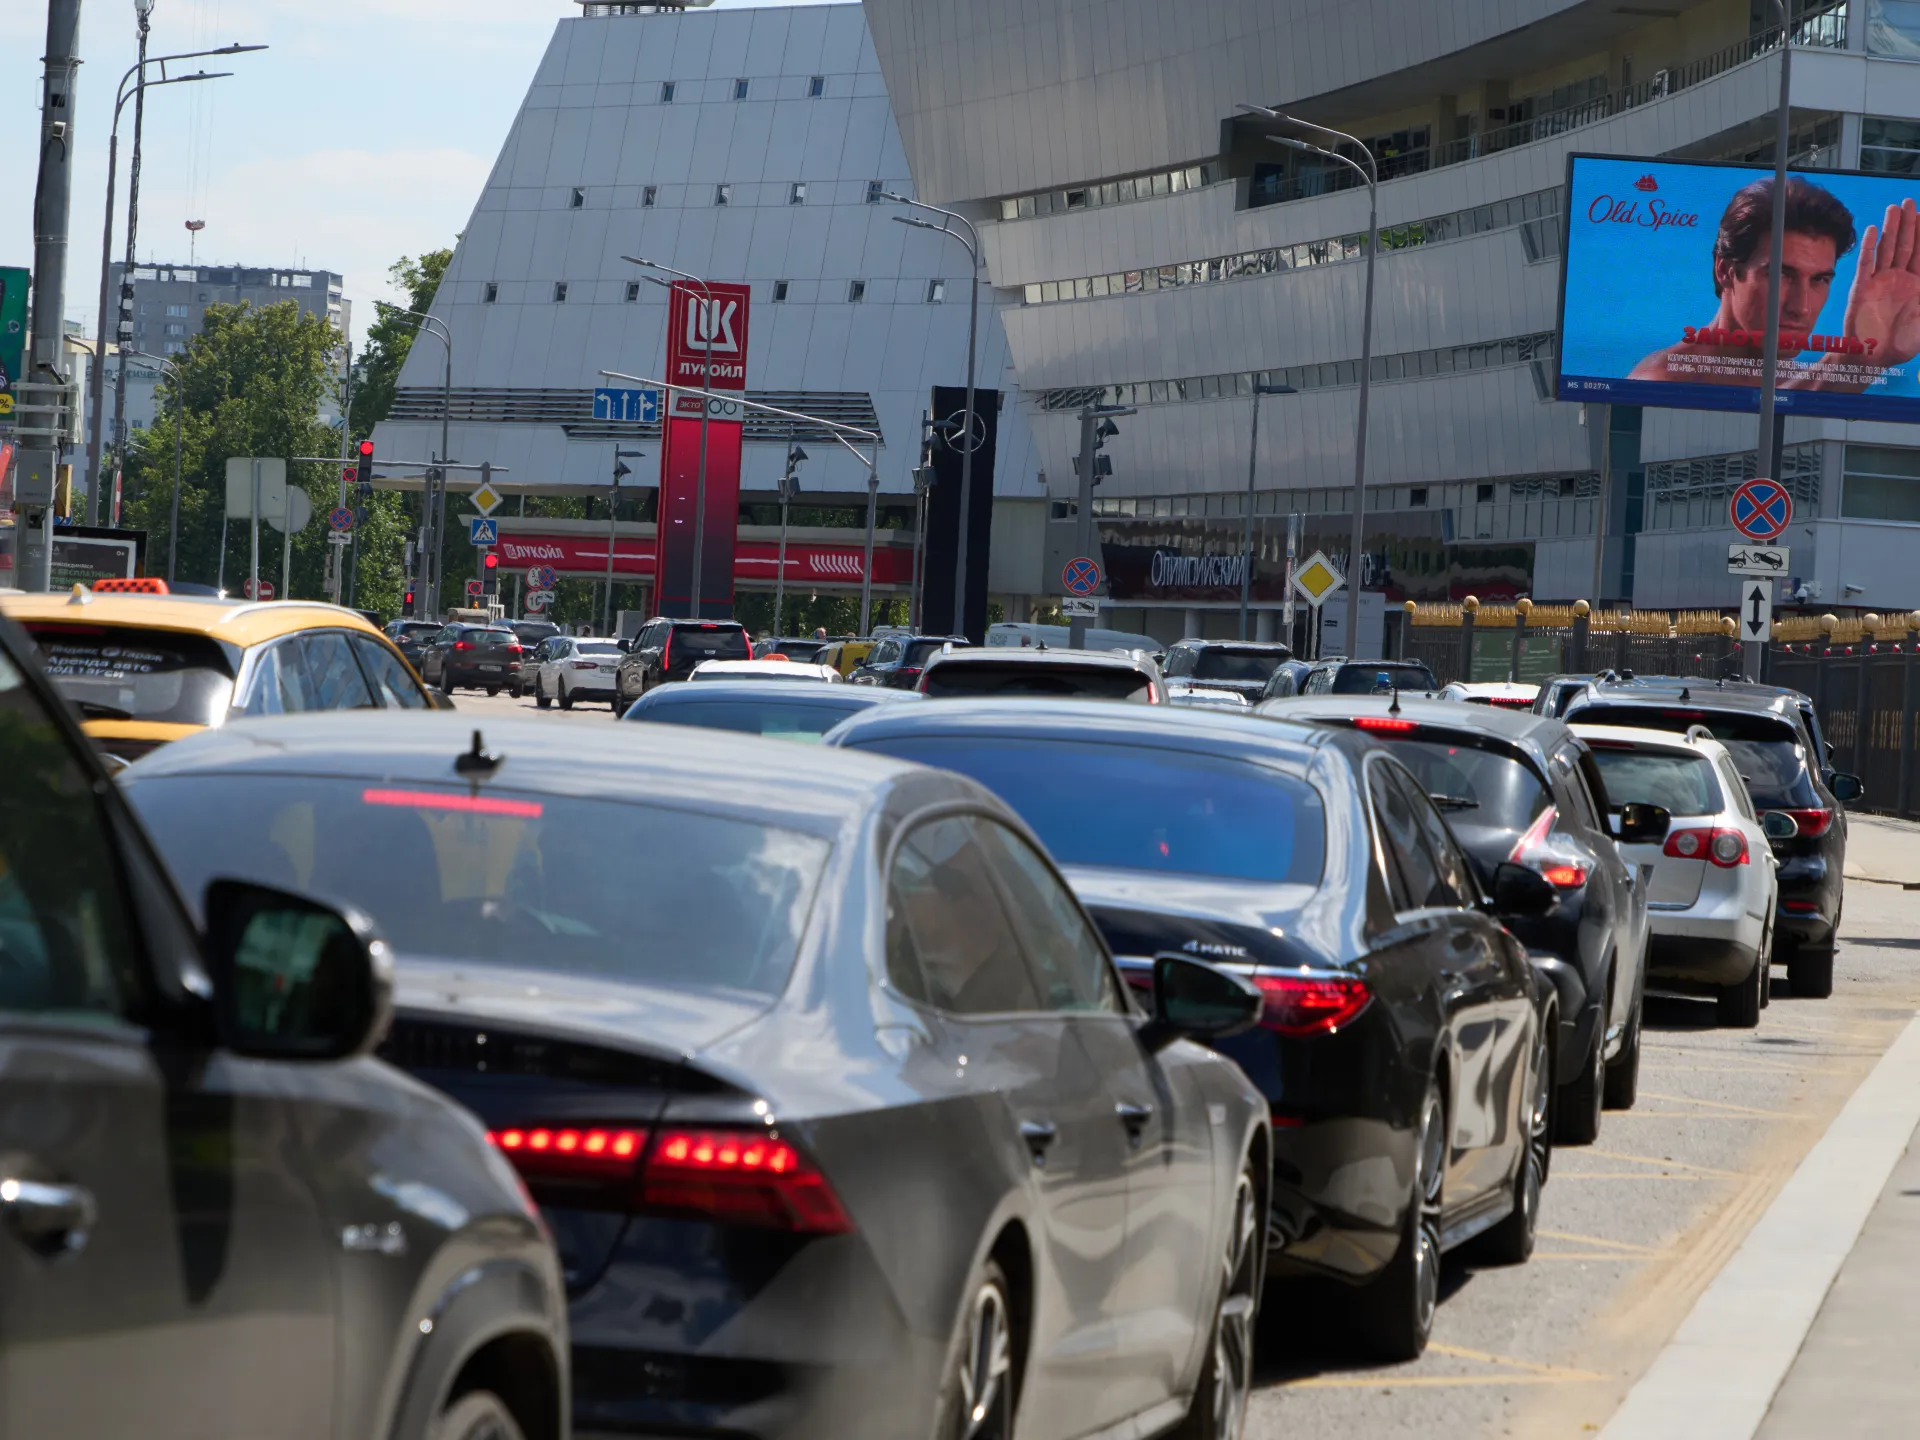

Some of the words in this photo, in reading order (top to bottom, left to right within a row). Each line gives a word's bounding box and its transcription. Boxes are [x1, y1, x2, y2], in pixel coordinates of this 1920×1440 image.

[1588, 194, 1634, 224] Old
[1637, 199, 1699, 231] Spice
[1683, 325, 1879, 356] ЗАПОТВАЕШЬ?
[1668, 354, 1701, 363] КОЛИЧЕСТВО
[1702, 355, 1721, 364] ТОВАРА
[516, 544, 564, 559] ЛУКОЙЛ
[48, 655, 110, 668] Аренда
[113, 661, 152, 672] авто
[79, 667, 125, 678] такси
